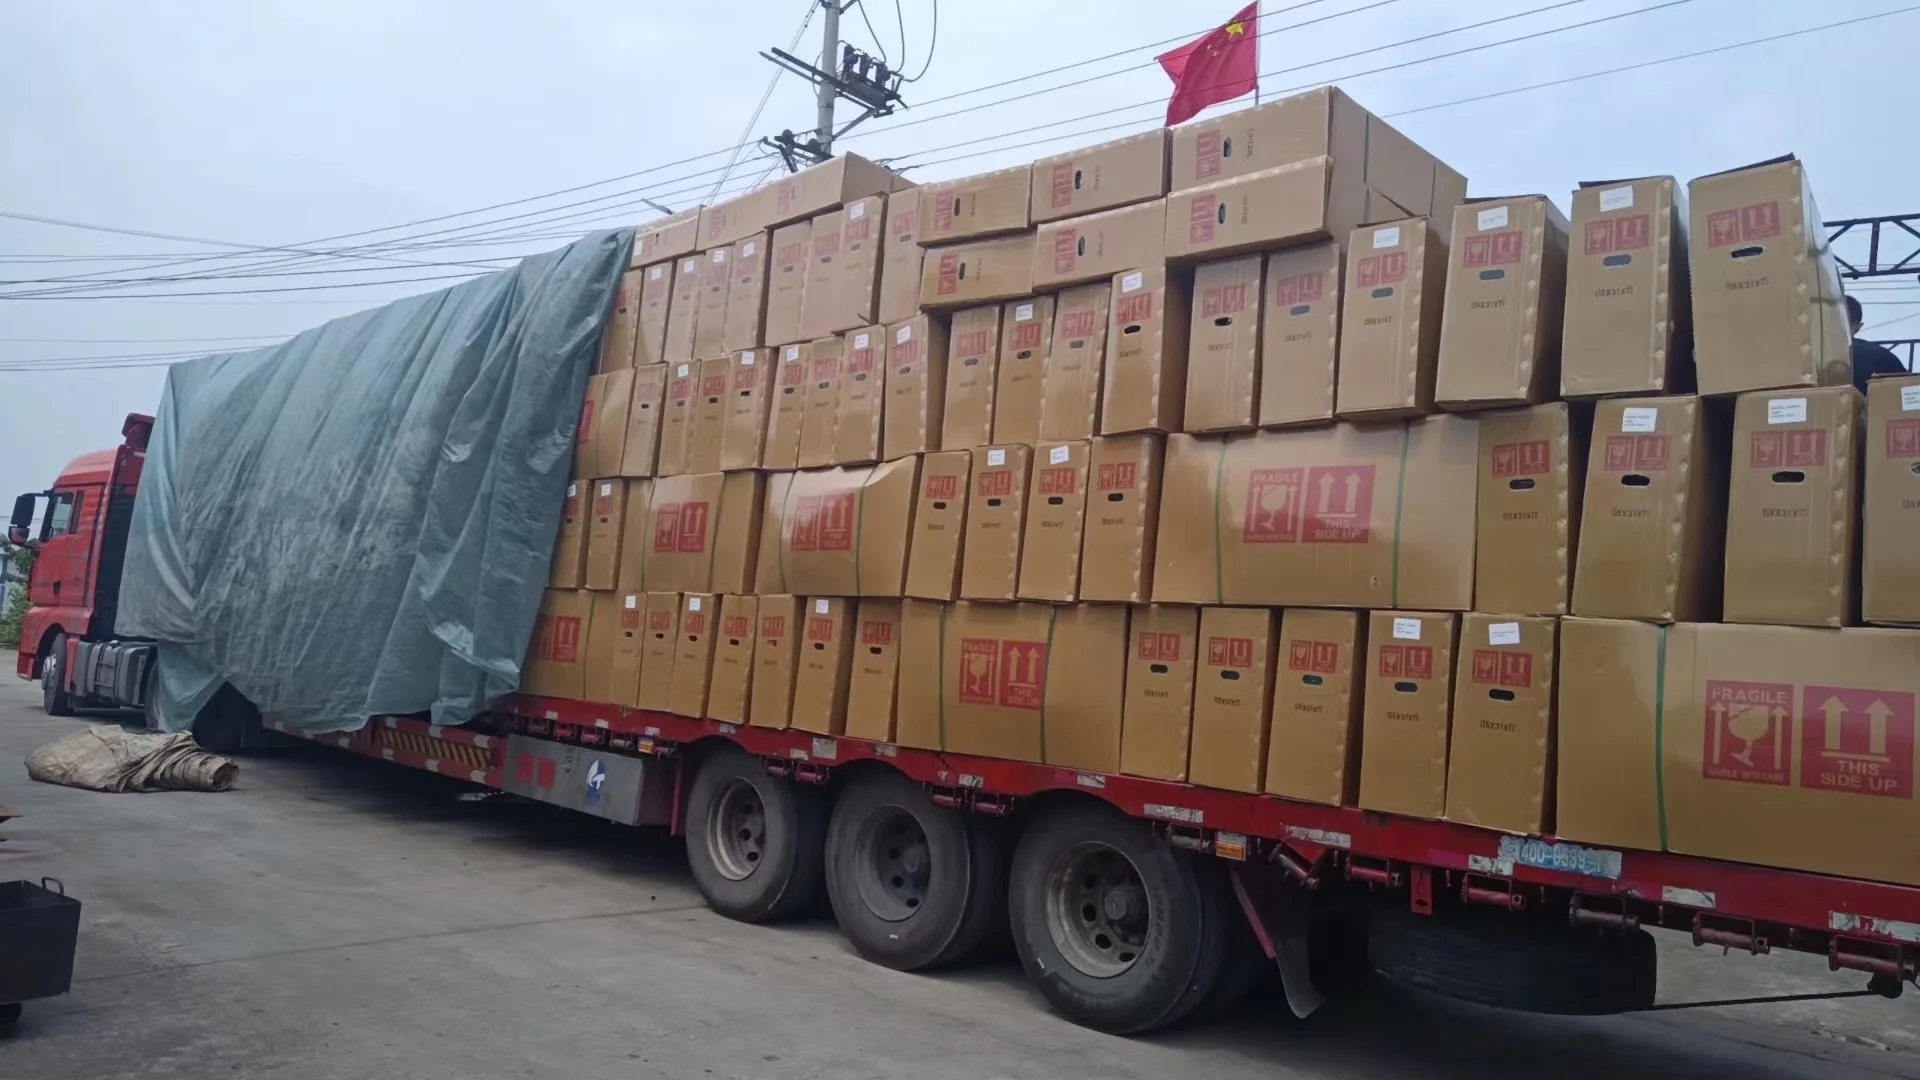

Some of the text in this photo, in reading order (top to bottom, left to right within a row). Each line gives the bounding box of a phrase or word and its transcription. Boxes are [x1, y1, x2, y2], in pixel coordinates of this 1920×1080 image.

[1253, 472, 1301, 483] FRAGILE
[1325, 519, 1351, 528] THIS
[1313, 530, 1339, 539] SIDE
[1711, 687, 1789, 705] FRAGILE
[1707, 767, 1785, 782] HANDLE WITH CARE
[1836, 760, 1880, 775] THIS
[1820, 774, 1897, 792] SIDE UP
